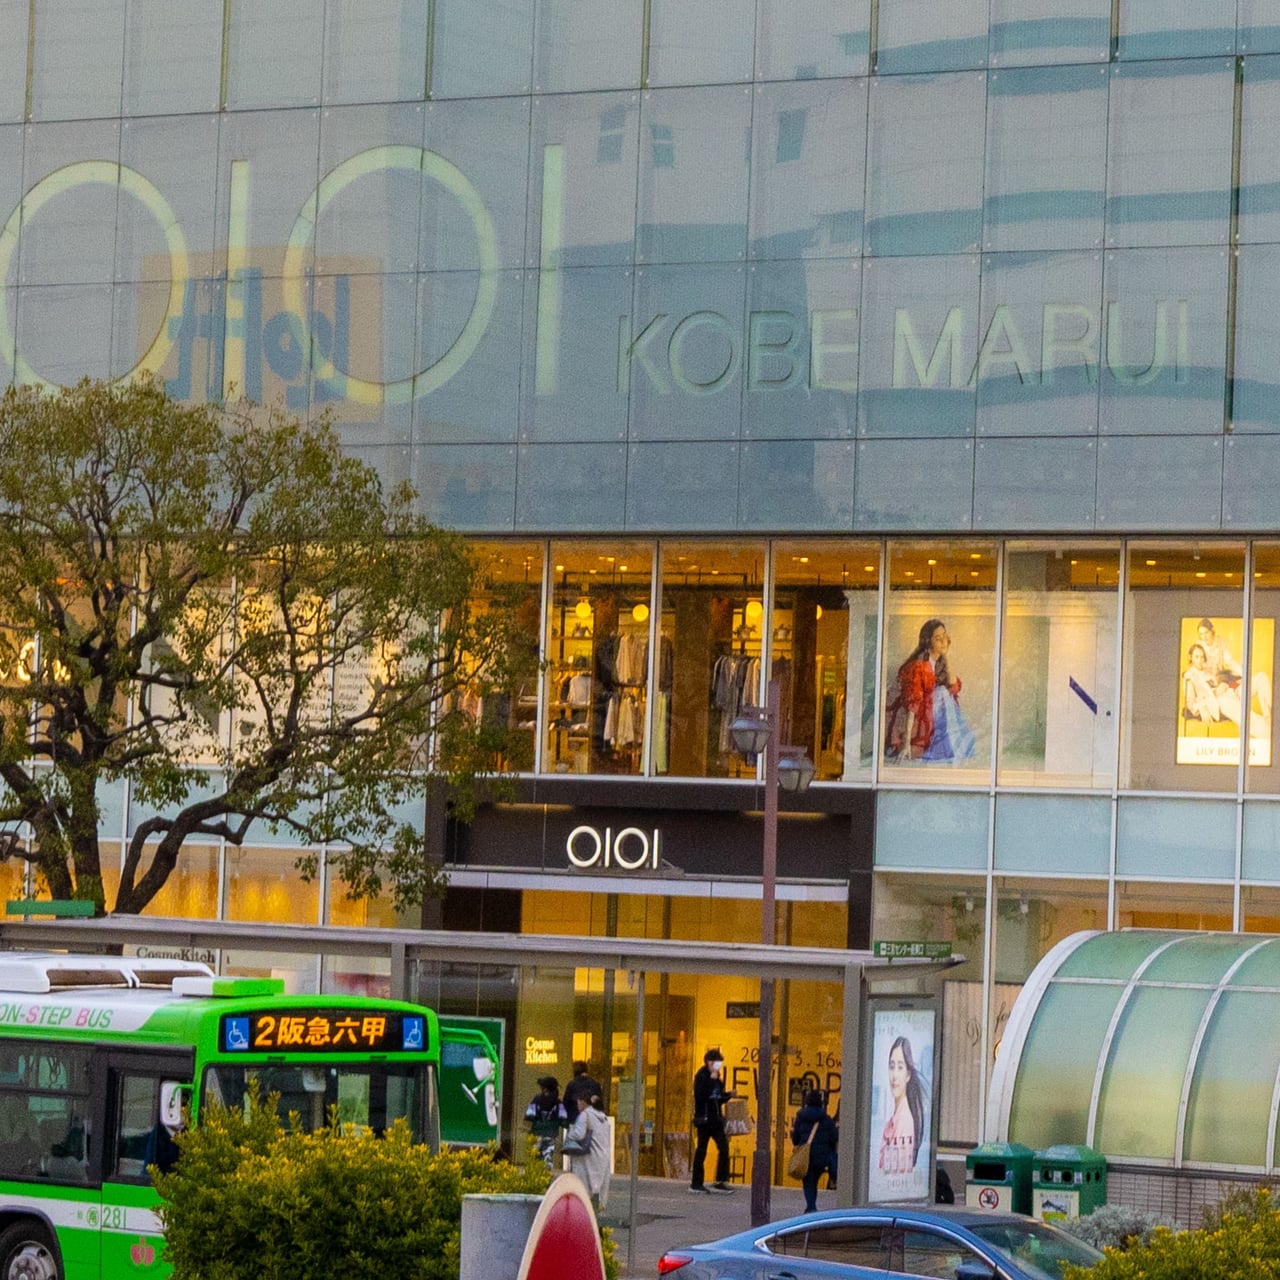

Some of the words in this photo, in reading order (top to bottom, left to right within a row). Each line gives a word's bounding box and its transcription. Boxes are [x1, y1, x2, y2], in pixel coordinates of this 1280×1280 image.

[617, 308, 859, 396] KOBE
[890, 299, 1189, 390] MARUI
[75, 1008, 113, 1028] BUS
[254, 1015, 387, 1047] 2阪急六甲
[103, 1206, 127, 1229] 281
